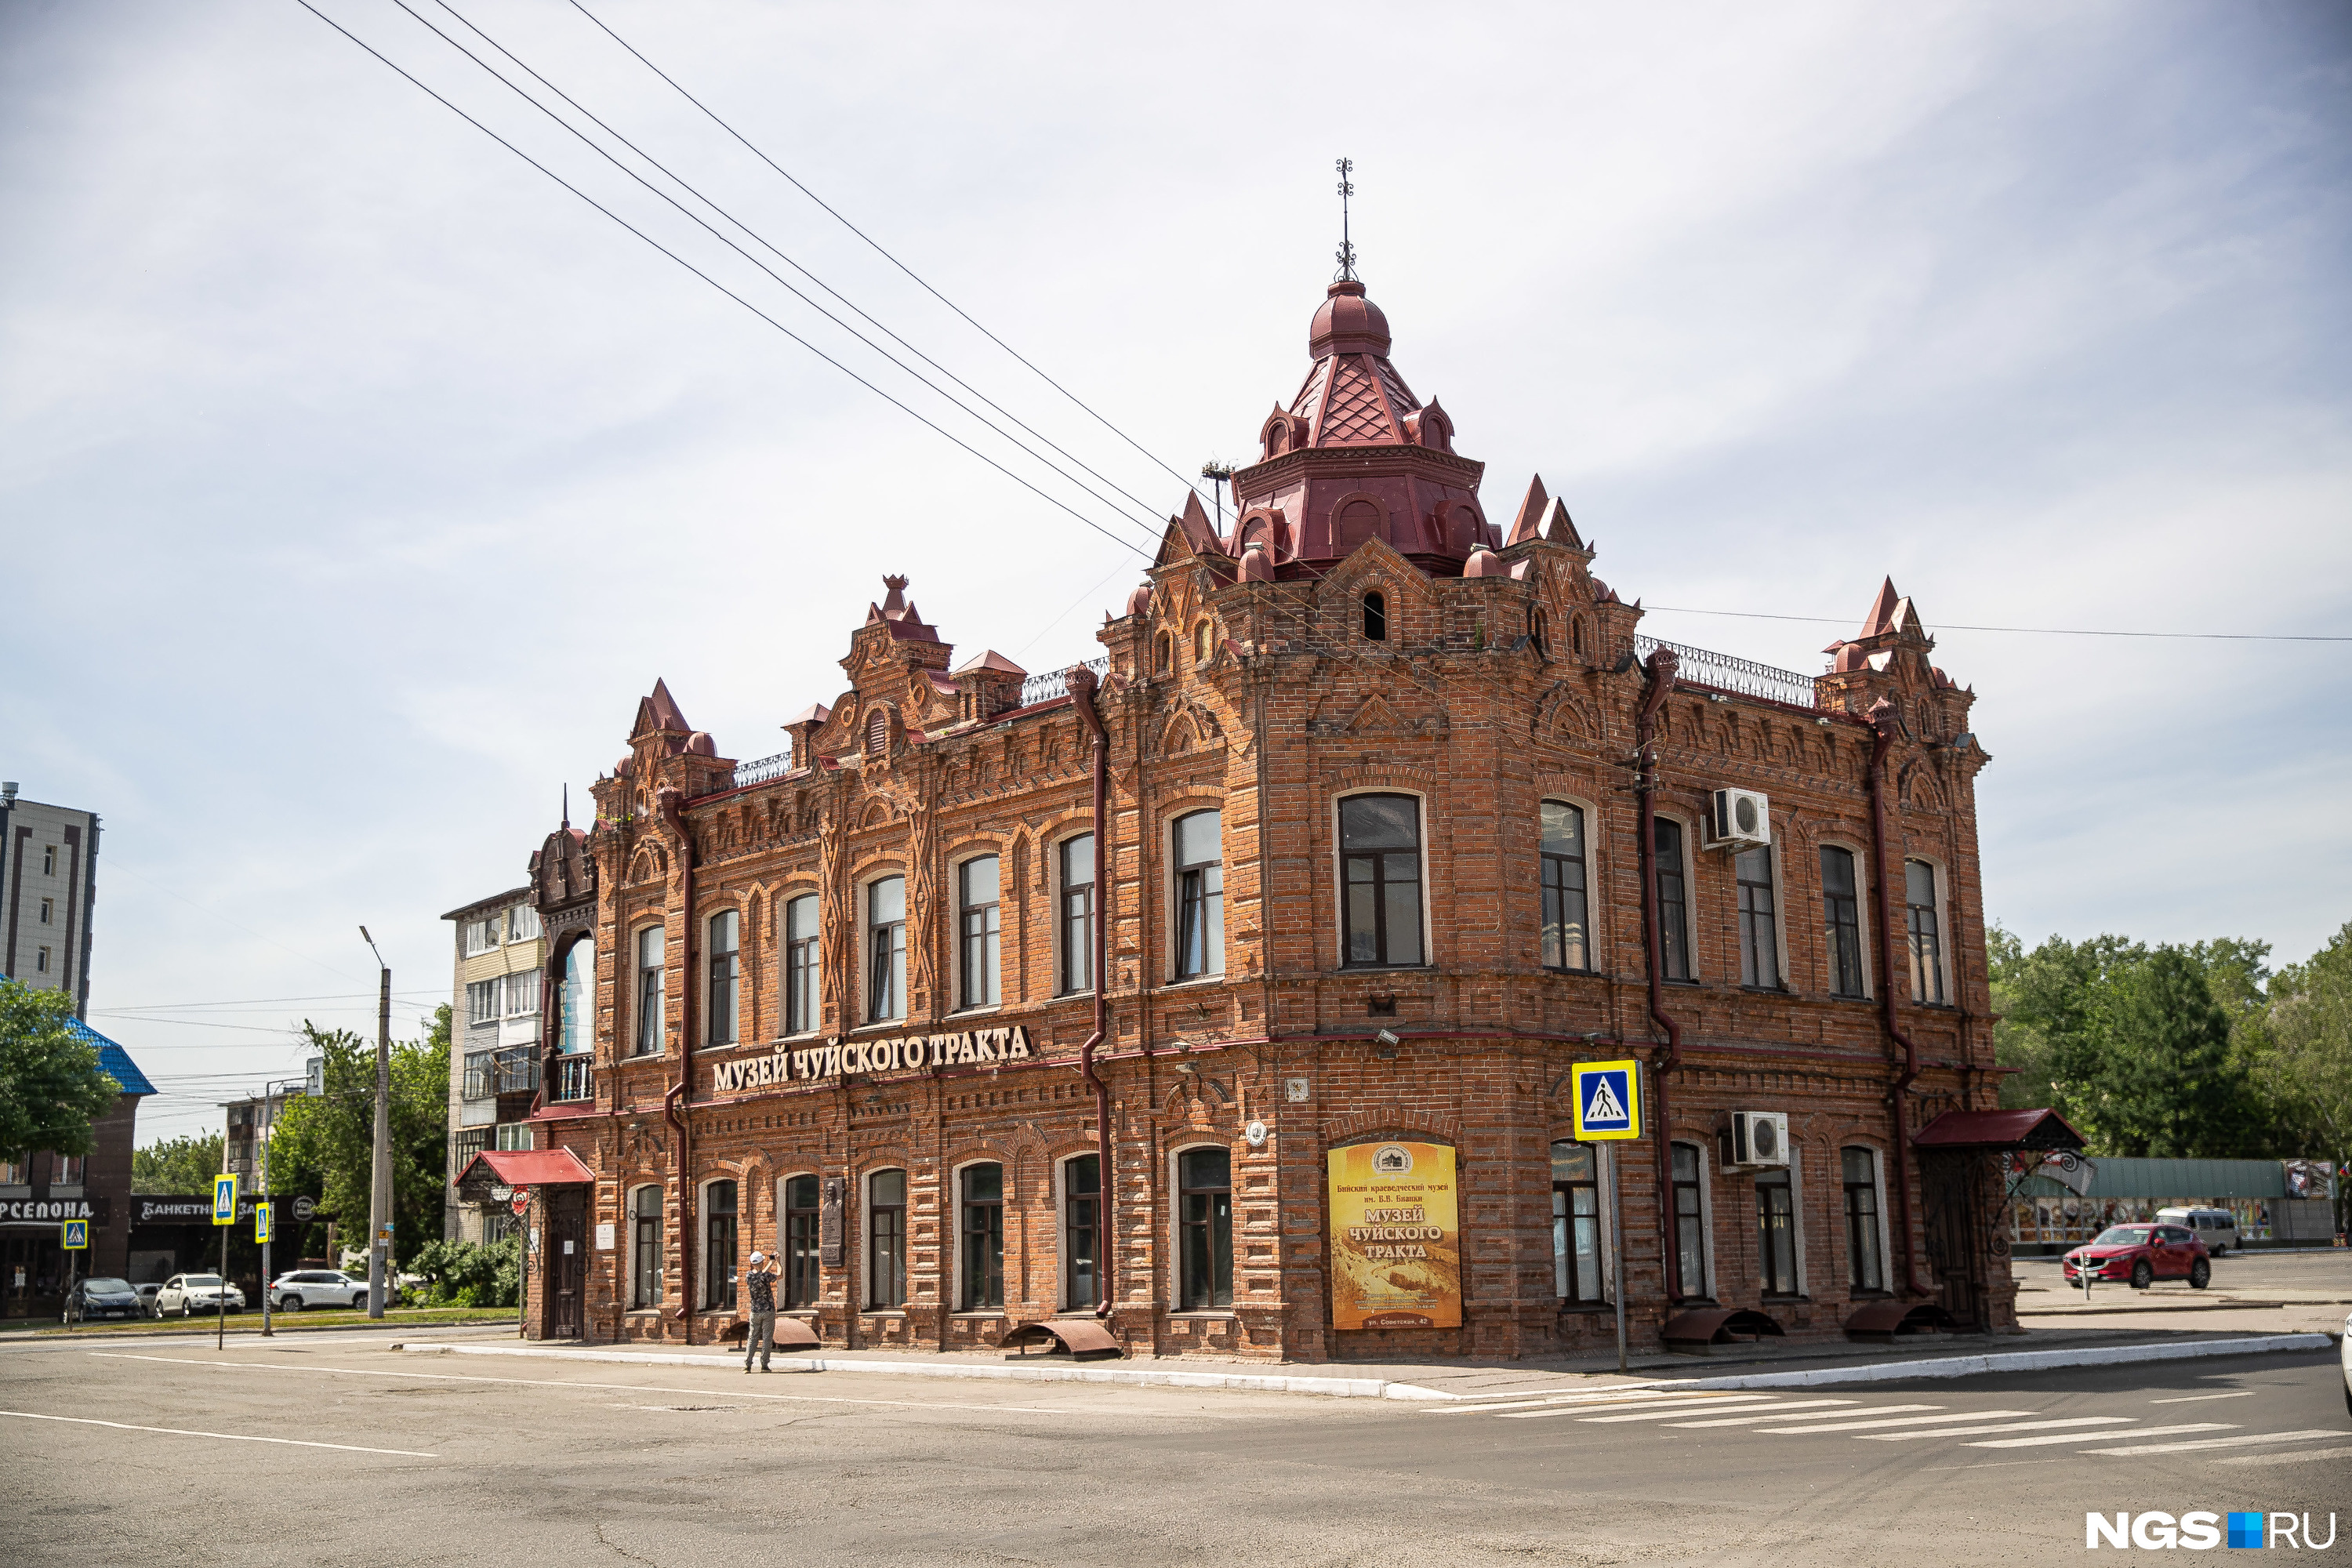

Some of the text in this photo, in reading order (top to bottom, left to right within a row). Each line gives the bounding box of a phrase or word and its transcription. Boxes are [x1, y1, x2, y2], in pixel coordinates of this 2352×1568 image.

[713, 1025, 1030, 1092] МУЗЕЙ ЧУЙСКОГО ТРАКТА
[1337, 1182, 1449, 1194] Бийский краеведческий музей
[141, 1201, 256, 1220] БАНКЕТН ЗА
[1365, 1204, 1425, 1223] МУЗЕЙ
[1348, 1224, 1443, 1241] ЧУЙСКОГО
[1364, 1244, 1428, 1258] ТРАКТА
